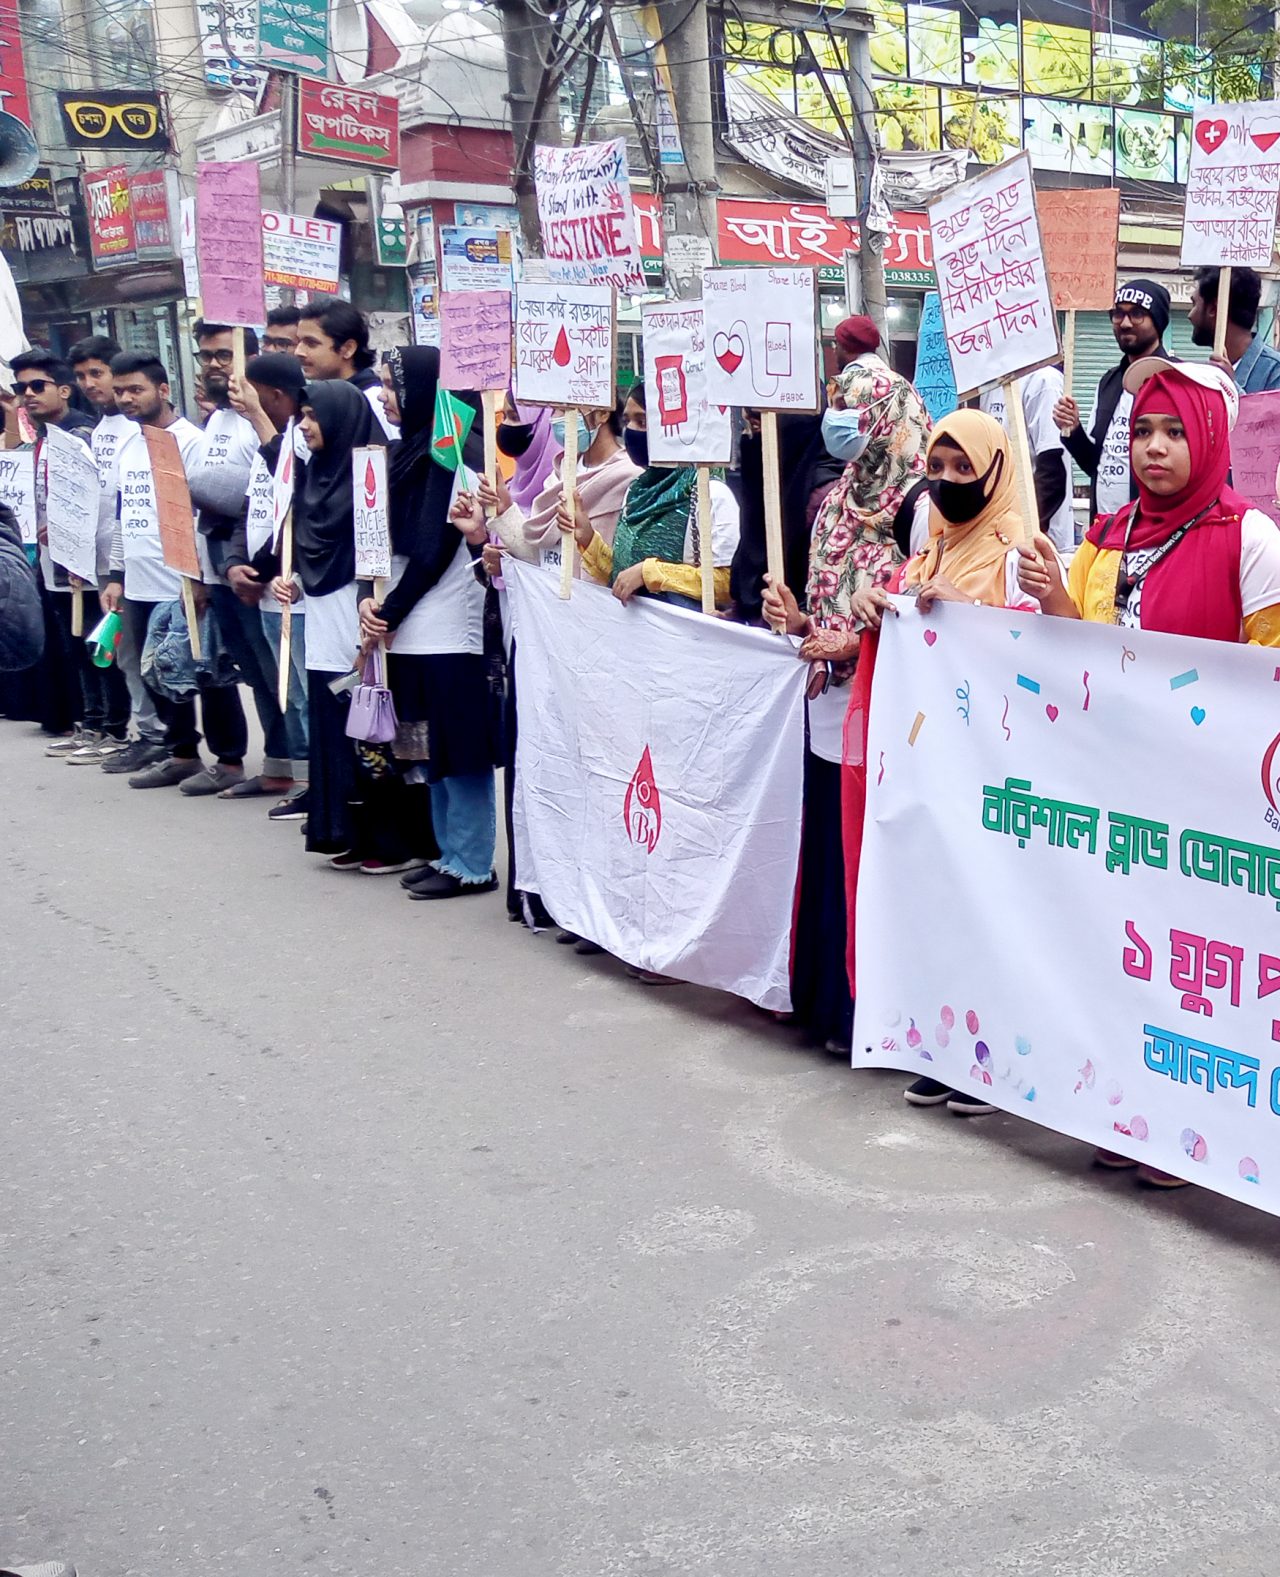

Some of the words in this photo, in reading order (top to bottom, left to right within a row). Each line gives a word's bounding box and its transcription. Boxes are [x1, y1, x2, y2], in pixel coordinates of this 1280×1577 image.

[77, 113, 104, 126] চশমা
[127, 114, 146, 126] ঘর
[321, 86, 380, 118] রেবন
[304, 112, 391, 149] অপটিকস্
[974, 179, 1025, 225] শুভ
[261, 213, 280, 231] O
[289, 217, 337, 242] LET
[723, 207, 847, 267] আই
[981, 214, 1032, 256] দিন
[625, 271, 646, 287] AM
[943, 257, 1040, 319] বিবিডিসির
[1114, 287, 1154, 310] HOPE
[948, 320, 991, 355] জন্ম
[0, 459, 21, 482] PPY
[981, 776, 1100, 854] বরিশাল
[1104, 811, 1170, 876] ব্লাড
[1122, 919, 1154, 982] ১
[1168, 927, 1245, 1018] যুগ
[1142, 1022, 1261, 1108] আনন্দ
